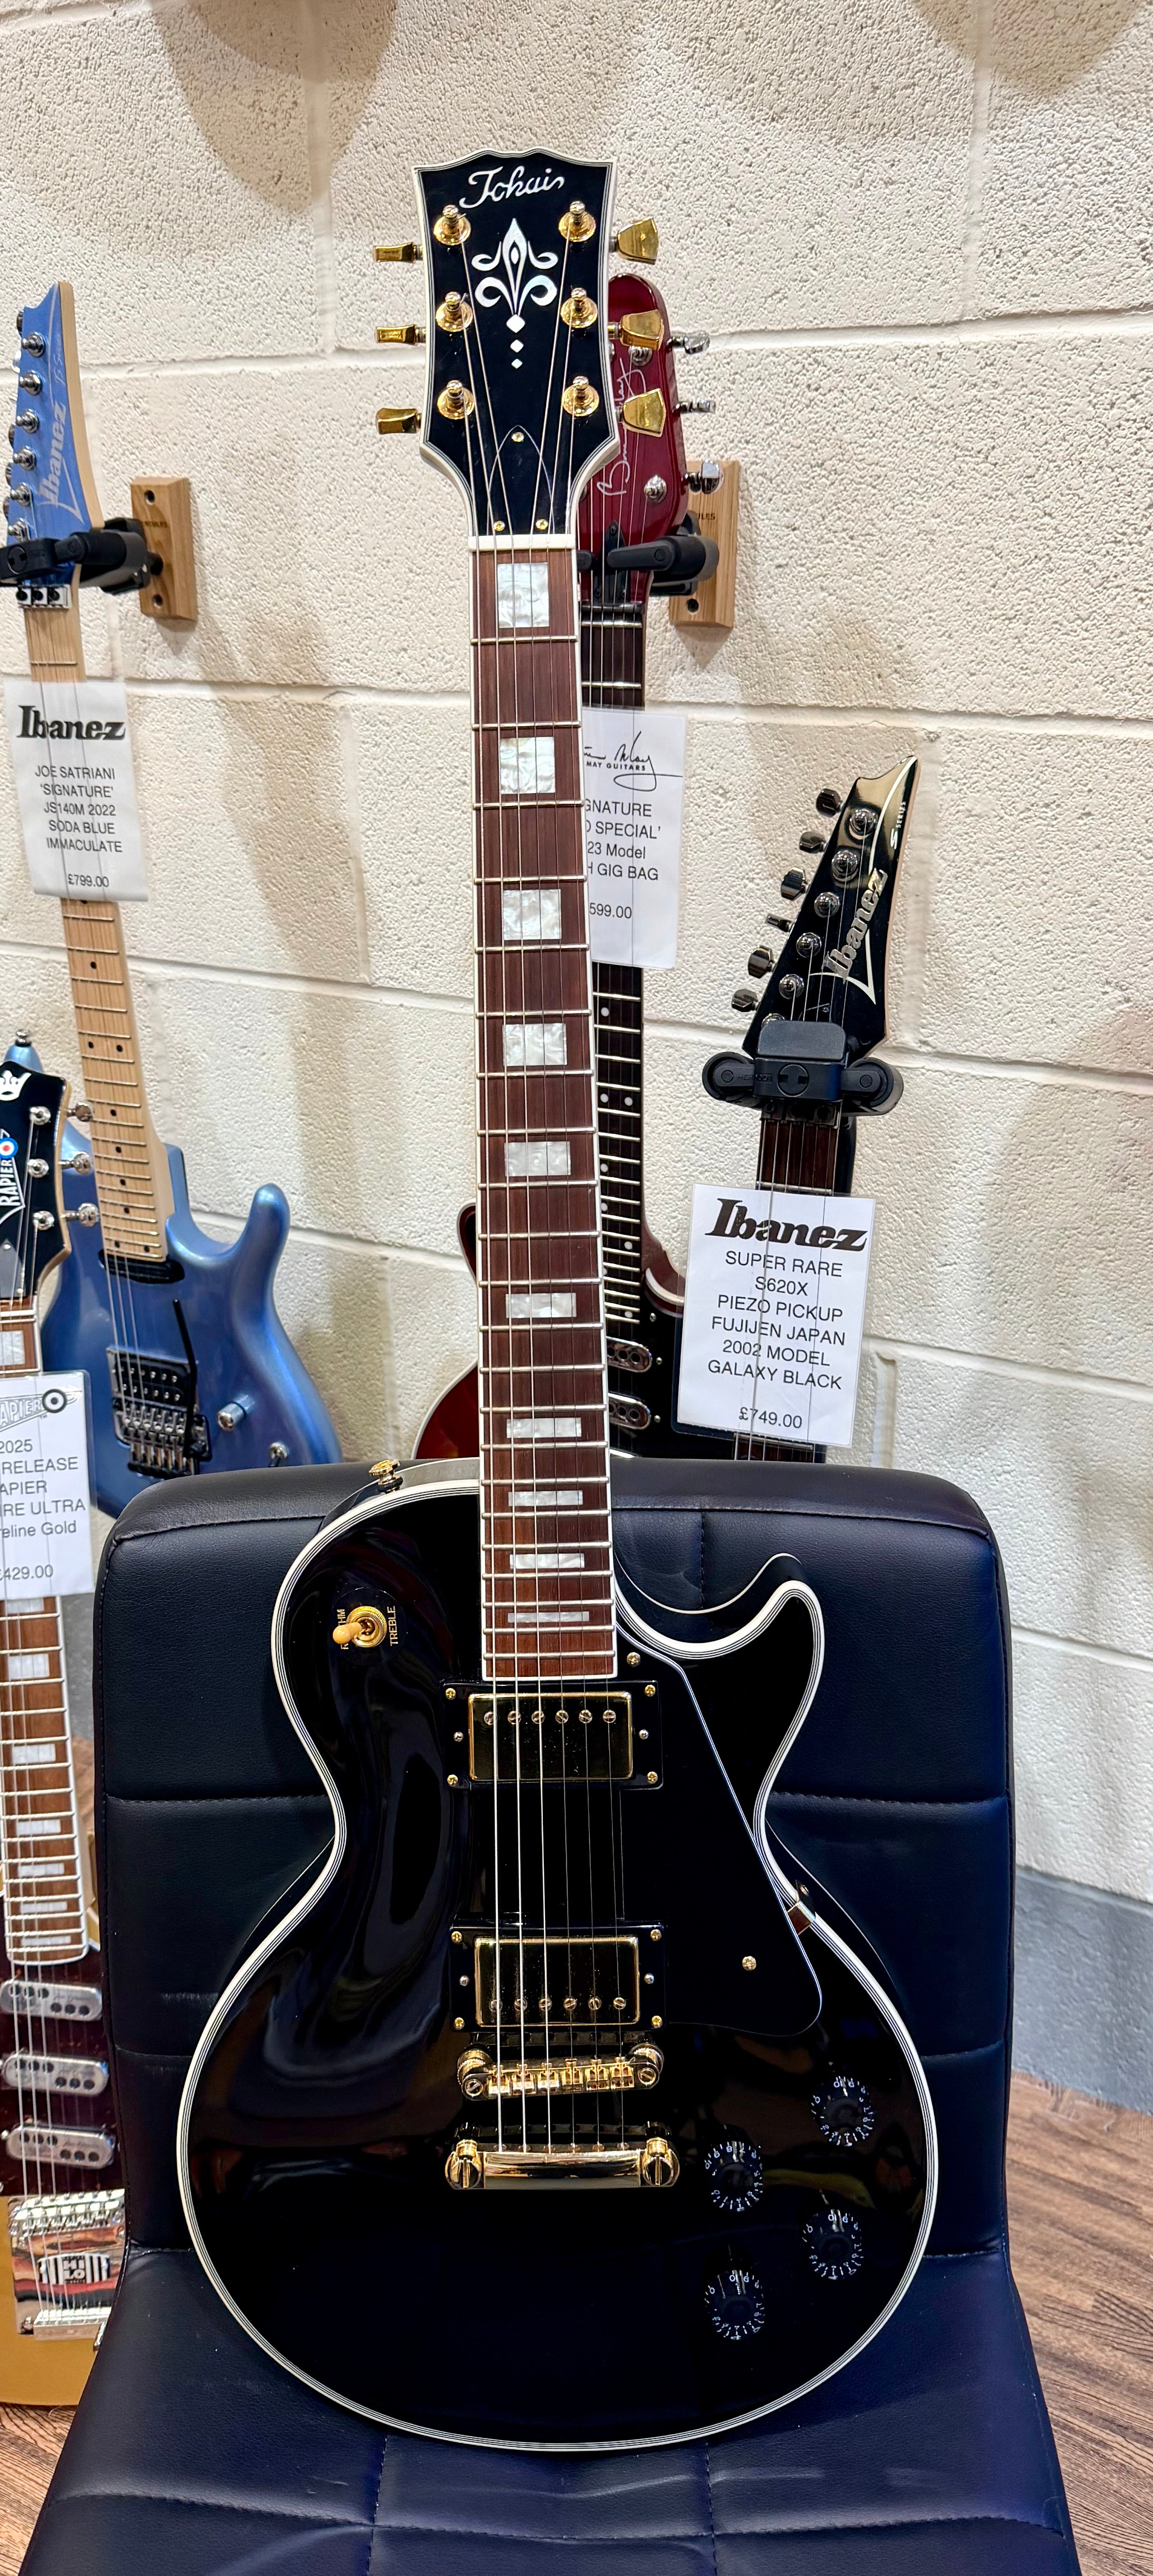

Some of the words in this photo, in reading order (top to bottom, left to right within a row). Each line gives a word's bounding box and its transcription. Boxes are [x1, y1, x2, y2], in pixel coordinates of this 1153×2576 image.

[40, 400, 66, 508] Ibanez
[17, 705, 125, 740] Ibanez
[35, 766, 57, 777] JOE
[60, 767, 115, 779] SATRIANI
[44, 802, 85, 815] JS140M
[88, 804, 116, 816] 2022
[585, 799, 652, 817] GNATURE
[896, 801, 906, 828] SERIES
[49, 820, 80, 833] SODA
[83, 822, 115, 834] BLUE
[595, 821, 661, 839] SPECIAL'
[47, 837, 123, 852] IMMACULATE
[588, 841, 602, 855] 23
[606, 843, 645, 859] Model
[68, 874, 109, 887] £799.00
[597, 863, 622, 877] GIG
[628, 866, 658, 880] BAG
[590, 902, 632, 919] 599.00
[821, 868, 888, 984] Ibanez
[0, 1159, 21, 1206] RAPIER
[705, 1198, 868, 1251] Ibanez
[726, 1251, 786, 1270] SUPER
[792, 1259, 843, 1277] RARE
[755, 1276, 808, 1296] S620X
[718, 1294, 770, 1313] PIEZO
[776, 1302, 843, 1322] PICKUP
[712, 1316, 781, 1338] FUJIJEN
[787, 1326, 845, 1346] JAPAN
[723, 1339, 761, 1357] 2002
[767, 1345, 830, 1366] MODEL
[708, 1360, 777, 1381] GALAXY
[783, 1370, 842, 1389] BLACK
[0, 1398, 43, 1426] APIER
[739, 1407, 802, 1429] £749.00
[0, 1439, 33, 1454] 2025
[2, 1457, 78, 1474] RELEASE
[0, 1480, 47, 1495] APIER
[31, 1499, 86, 1515] ULTRA
[0, 1524, 36, 1538] eline
[41, 1520, 77, 1535] Gold
[0, 1564, 54, 1581] 429.00
[337, 1609, 349, 1650] RHM
[387, 1605, 399, 1646] TREBLE
[63, 2259, 85, 2270] HI
[63, 2269, 86, 2280] LO
